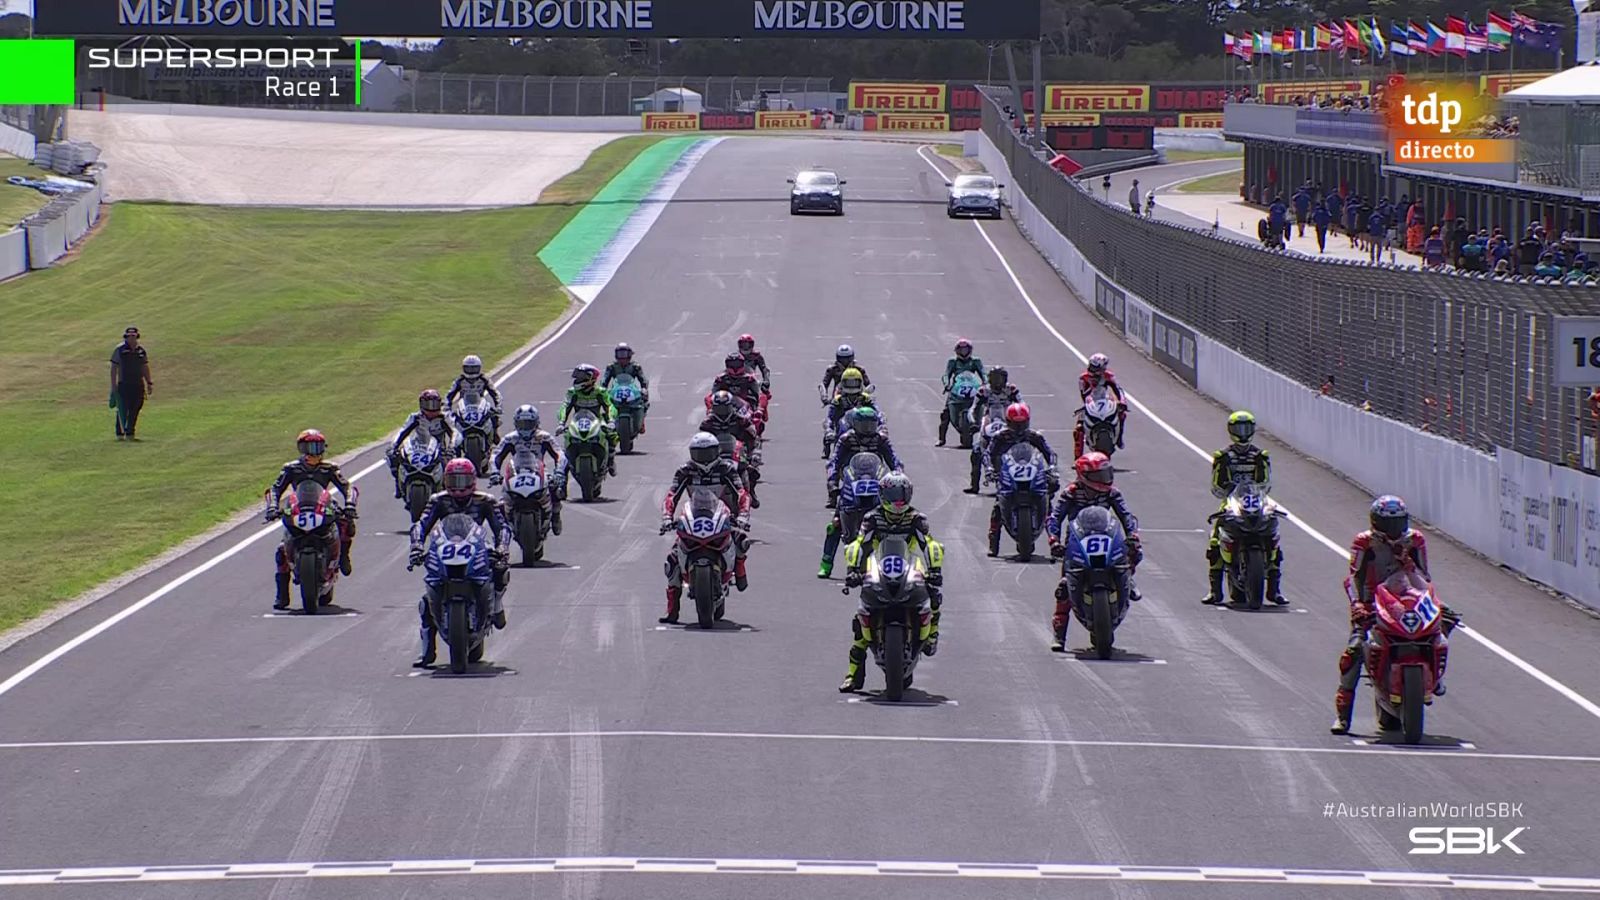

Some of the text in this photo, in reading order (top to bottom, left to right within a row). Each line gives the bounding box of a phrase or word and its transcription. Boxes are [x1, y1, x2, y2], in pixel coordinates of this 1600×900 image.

[118, 0, 336, 27] MELBOURNE
[441, 0, 653, 29] MELBOURNE
[753, 0, 965, 30] MELBOURNE
[854, 86, 941, 110] PIRELLI
[1052, 88, 1144, 110] PIRELLI
[646, 114, 697, 130] PIRELLI
[759, 113, 808, 128] PIRELLI
[882, 116, 945, 130] PIRELLI
[1097, 402, 1105, 412] 7
[411, 453, 431, 465] 24
[1013, 466, 1033, 478] 21
[514, 476, 536, 488] 23
[855, 480, 880, 494] 62
[1243, 495, 1259, 509] 32
[297, 511, 317, 528] 51
[692, 519, 714, 532] 53
[1086, 534, 1110, 552] 61
[441, 543, 473, 560] 94
[883, 557, 904, 574] 69
